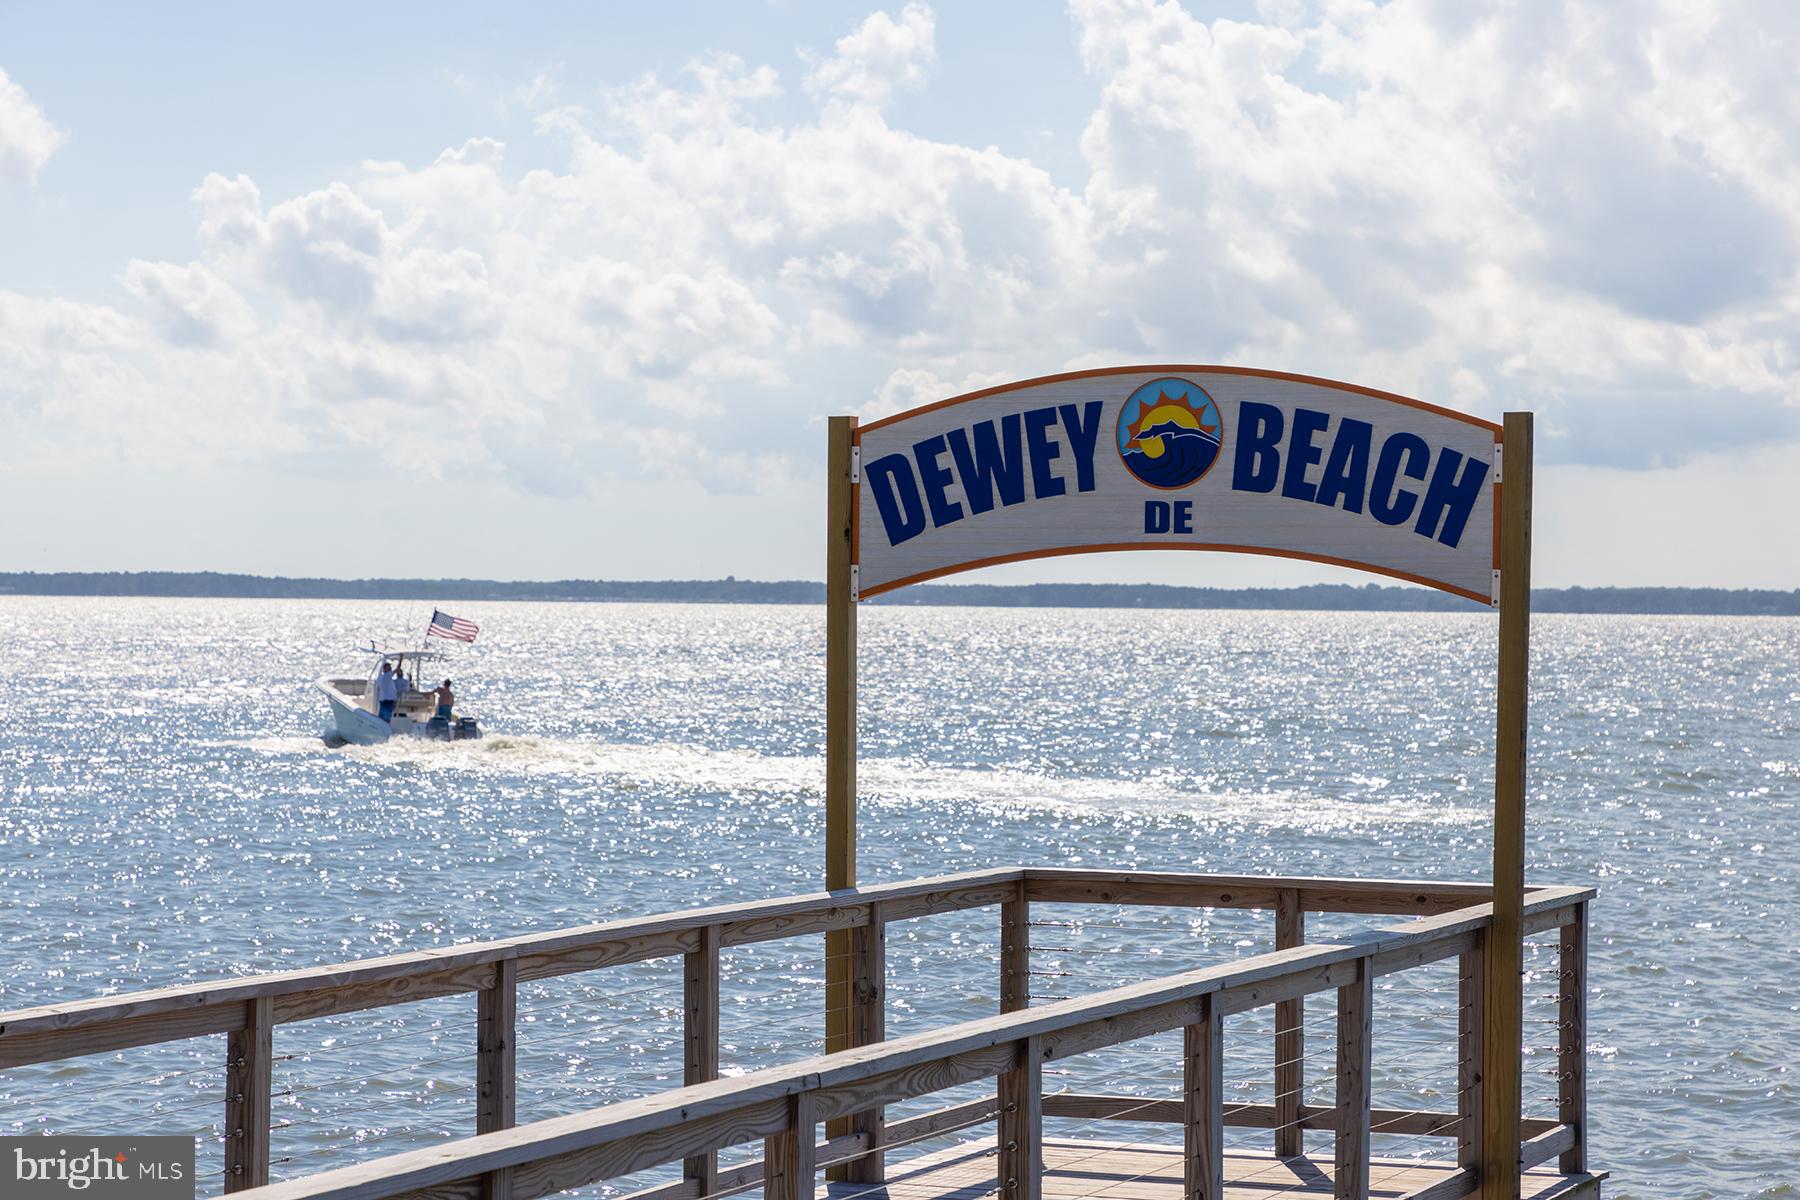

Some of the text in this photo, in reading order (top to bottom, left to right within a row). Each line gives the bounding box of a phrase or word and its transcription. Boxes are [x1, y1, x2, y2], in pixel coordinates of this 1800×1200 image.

[864, 400, 1490, 549] DEWEY BEACH
[1143, 500, 1194, 535] DE
